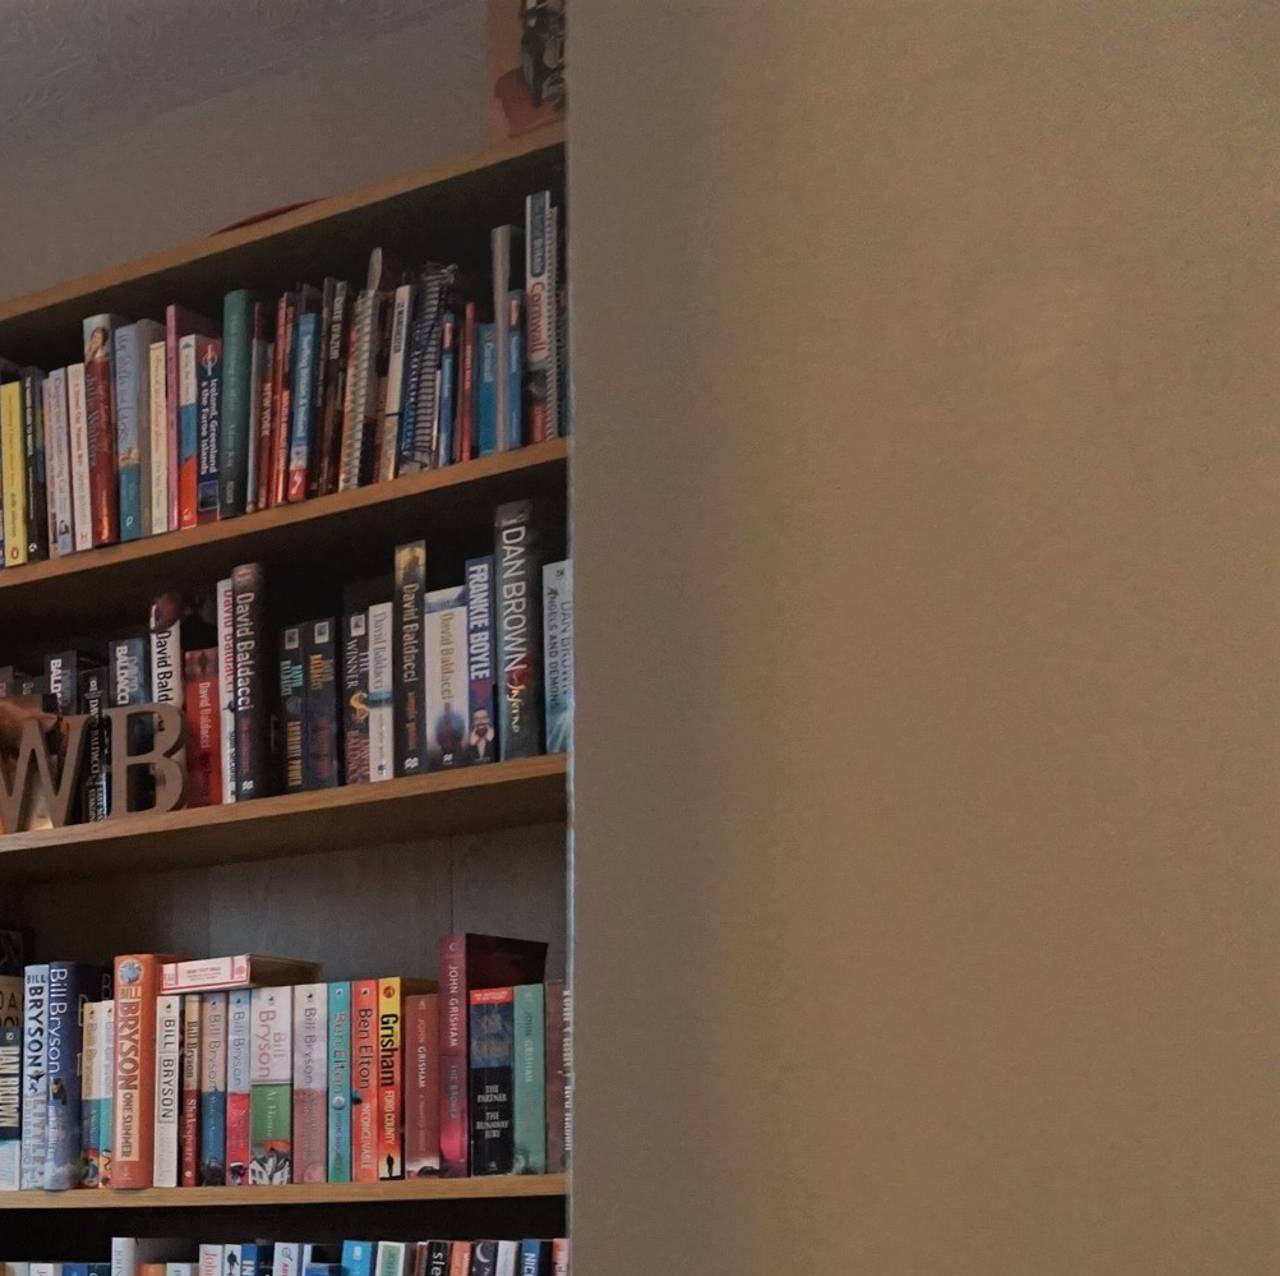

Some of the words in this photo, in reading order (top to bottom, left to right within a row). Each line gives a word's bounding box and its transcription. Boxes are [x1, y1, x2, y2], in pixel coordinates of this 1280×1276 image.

[530, 281, 548, 354] Cornwall
[200, 387, 209, 404] the
[208, 378, 218, 417] Iceland,
[262, 383, 272, 407] NEW
[297, 368, 309, 395] Britain
[86, 412, 99, 467] Walters
[200, 407, 209, 436] Faroe
[261, 410, 271, 437] YORK
[200, 438, 209, 475] Islands
[208, 419, 218, 473] Greenland
[500, 525, 527, 577] DAN
[236, 592, 255, 636] David
[402, 583, 420, 622] David
[468, 564, 490, 629] FRANKIE
[372, 612, 388, 644] David
[437, 612, 455, 646] David
[502, 581, 527, 673] BROWN
[548, 634, 559, 657] AND
[115, 644, 130, 705] BALDACCI
[345, 639, 359, 689] WINNER
[372, 647, 388, 690] Baldacci
[402, 624, 420, 683] Baldacci
[437, 648, 455, 701] Baldacci
[469, 634, 491, 681] BOYLE
[198, 681, 210, 707] David
[236, 640, 254, 712] Baldacci
[549, 659, 560, 708] DEMONS
[199, 709, 210, 749] Baldacci
[505, 682, 526, 735] Inferno
[48, 967, 68, 998] Bill
[448, 964, 458, 994] JOHN
[28, 984, 44, 1067] BRYSON
[48, 1001, 64, 1074] Bryson
[163, 1018, 176, 1048] BILL
[186, 1020, 198, 1040] Bill
[208, 1013, 222, 1037] Bill
[233, 1011, 247, 1035] Bill
[304, 1007, 317, 1030] Bill
[359, 1007, 374, 1040] Ben
[448, 998, 458, 1048] GRISHAM
[118, 1001, 139, 1091] BRYSON
[184, 1042, 197, 1079] Bryson
[207, 1039, 221, 1091] Bryson
[231, 1037, 246, 1087] Bryson
[256, 1009, 277, 1078] Bryson
[273, 1031, 288, 1058] Bill
[302, 1034, 317, 1083] Bryson
[381, 1012, 399, 1088] Grisham
[358, 1044, 374, 1089] Elton
[417, 1045, 427, 1089] GRISHAM
[122, 1092, 134, 1113] ONE
[160, 1058, 175, 1120] BRYSON
[384, 1090, 396, 1110] FORD
[120, 1113, 135, 1158] SUMMER
[183, 1098, 198, 1162] Shakespeare
[384, 1112, 396, 1145] COUNTY
[242, 1259, 254, 1276] IN
